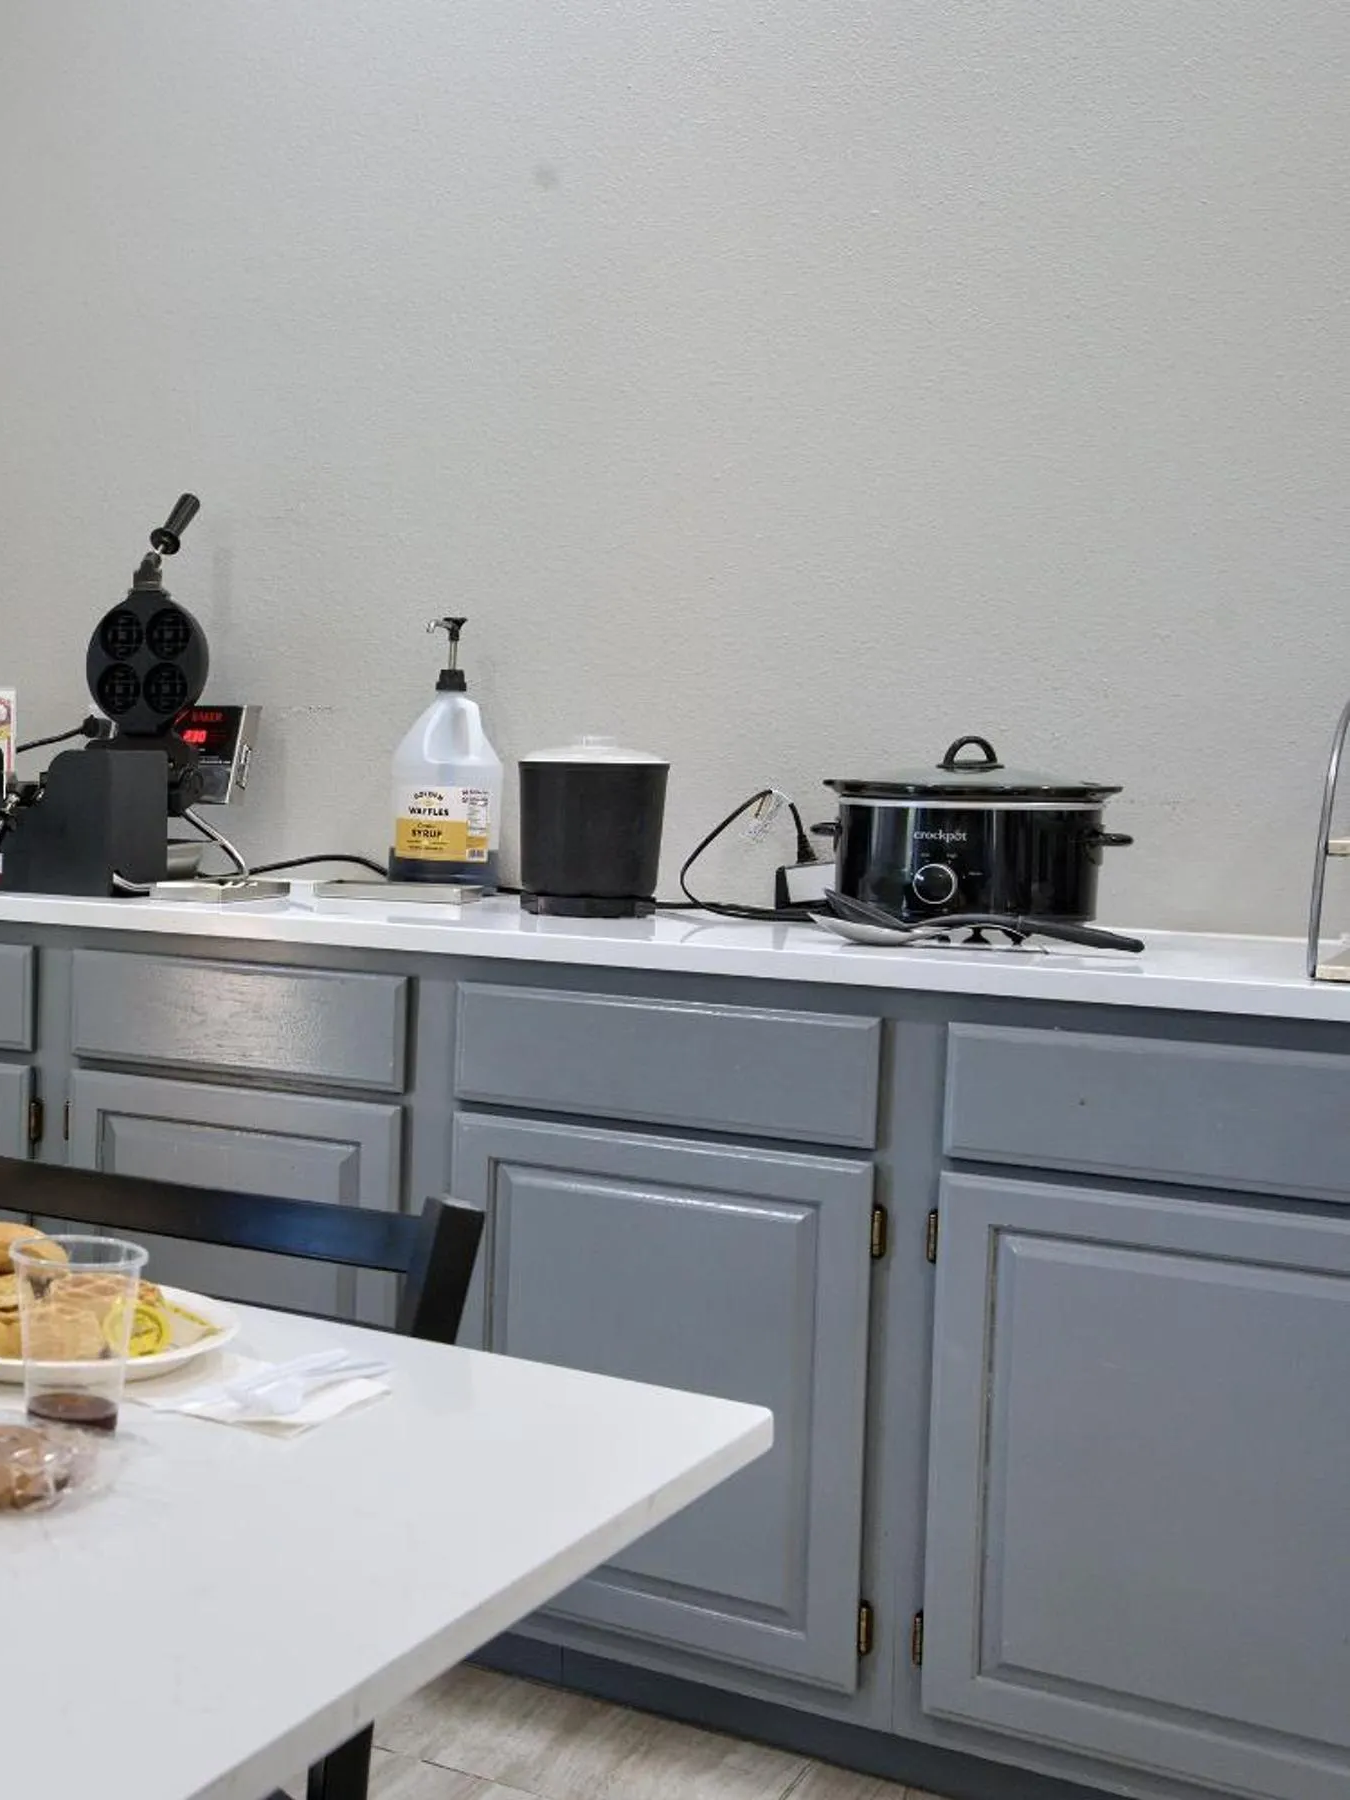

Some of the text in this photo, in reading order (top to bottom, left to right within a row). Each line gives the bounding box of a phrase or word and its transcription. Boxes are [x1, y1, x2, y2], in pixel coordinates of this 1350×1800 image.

[408, 806, 449, 816] WAFFLES
[411, 829, 442, 838] SYRUP
[913, 829, 967, 843] crockpot
